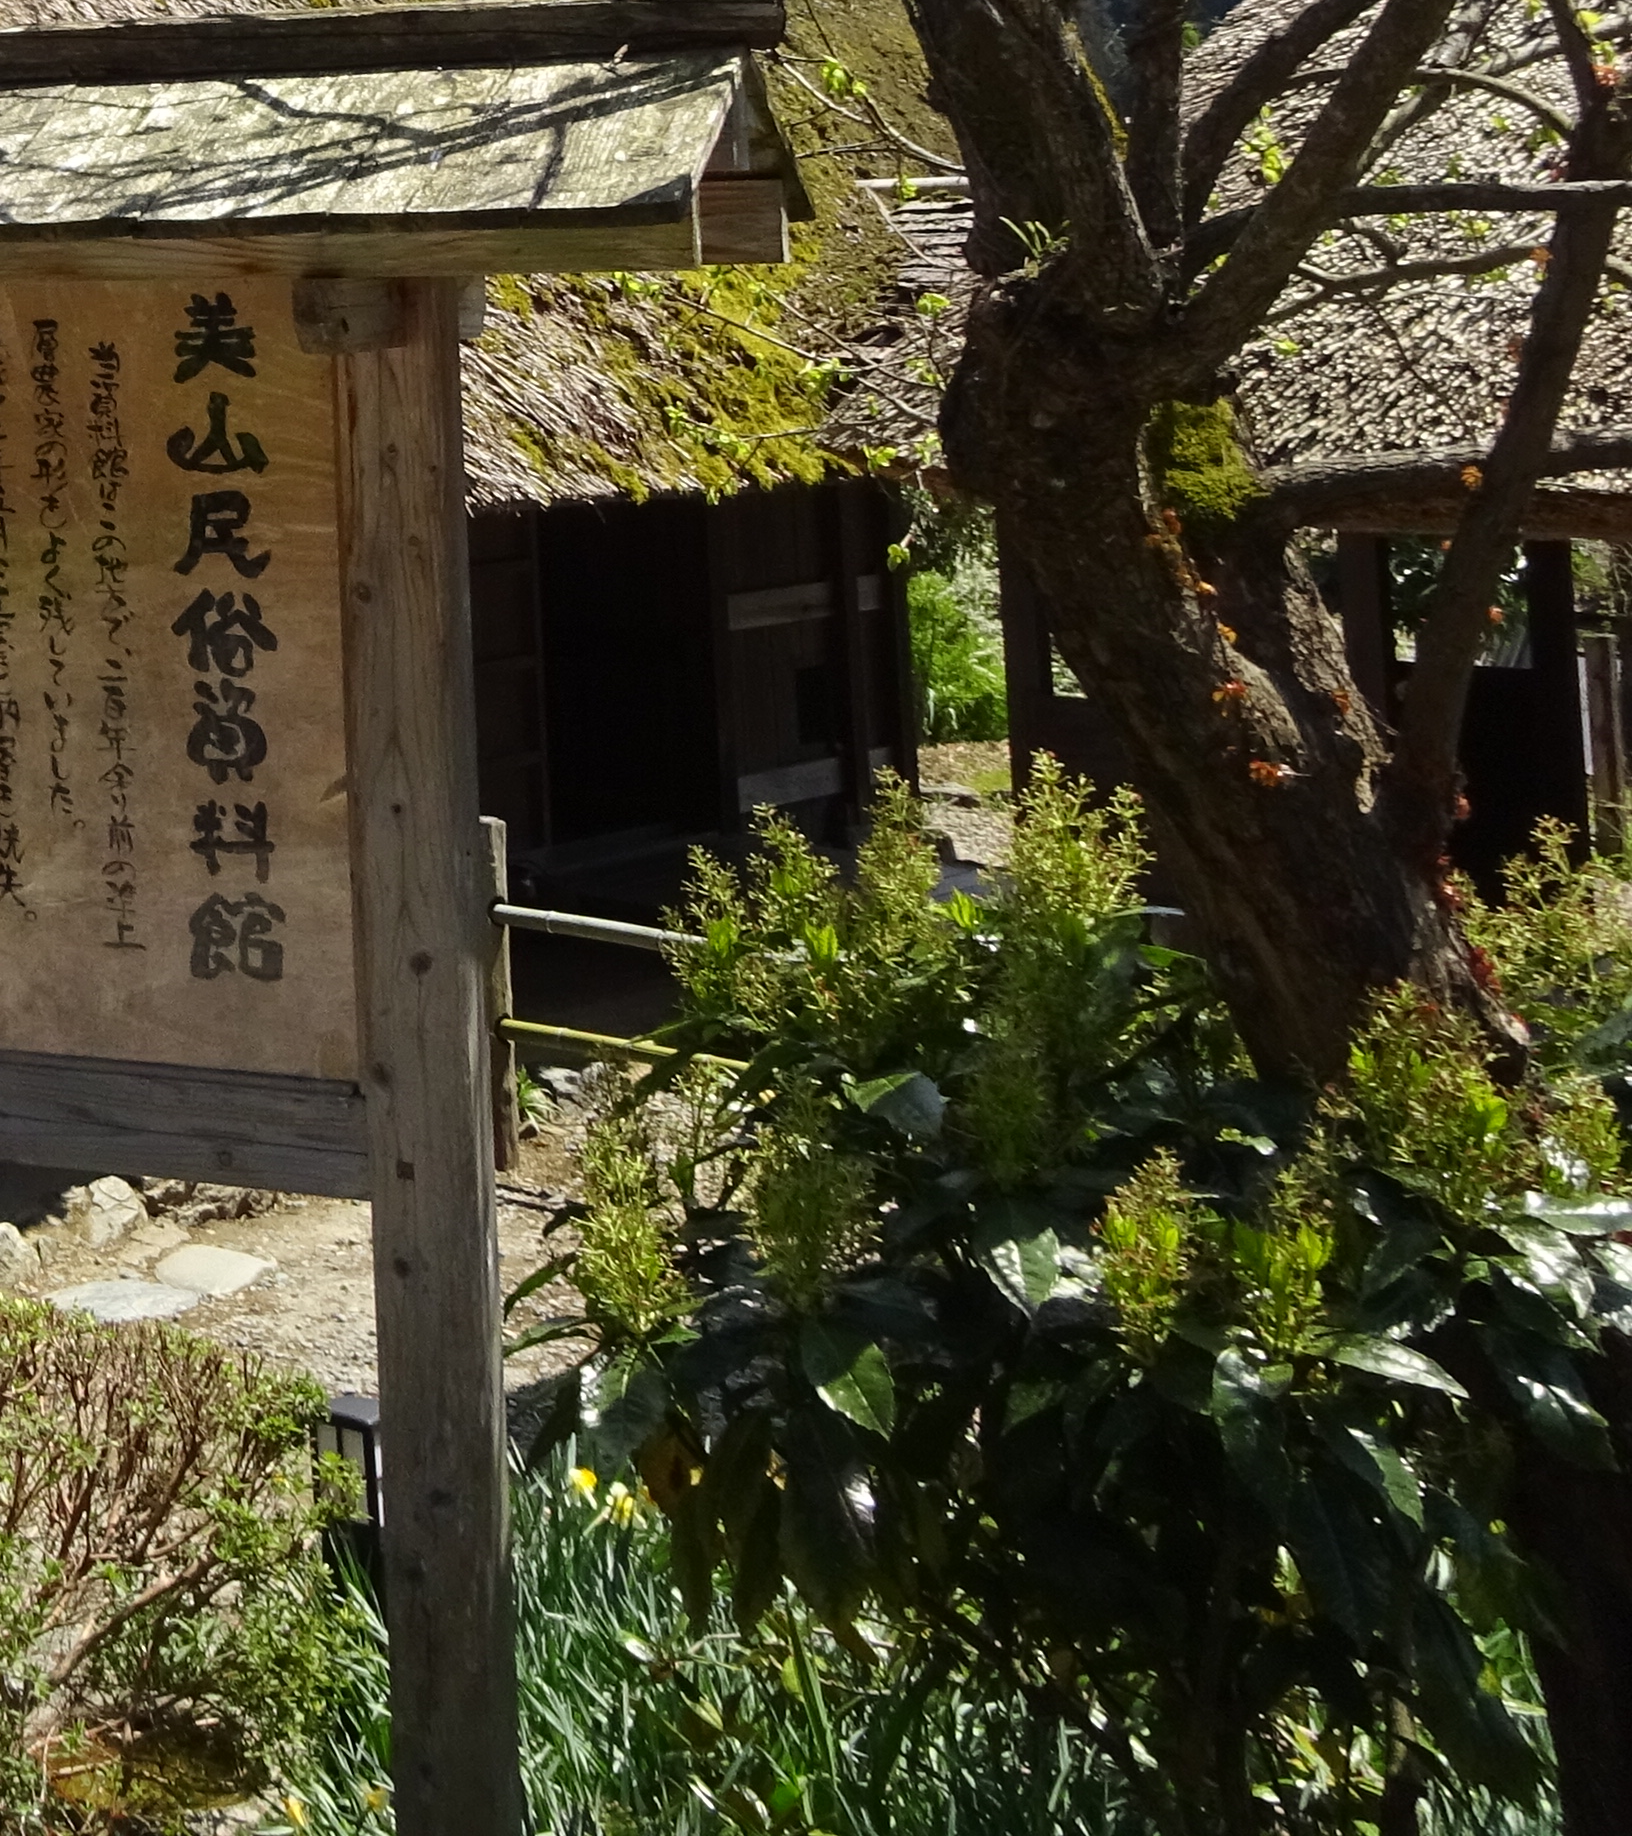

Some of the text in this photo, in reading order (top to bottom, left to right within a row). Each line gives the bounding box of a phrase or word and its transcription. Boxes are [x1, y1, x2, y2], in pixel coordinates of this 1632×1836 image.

[166, 292, 286, 982] 美山民俗資料館
